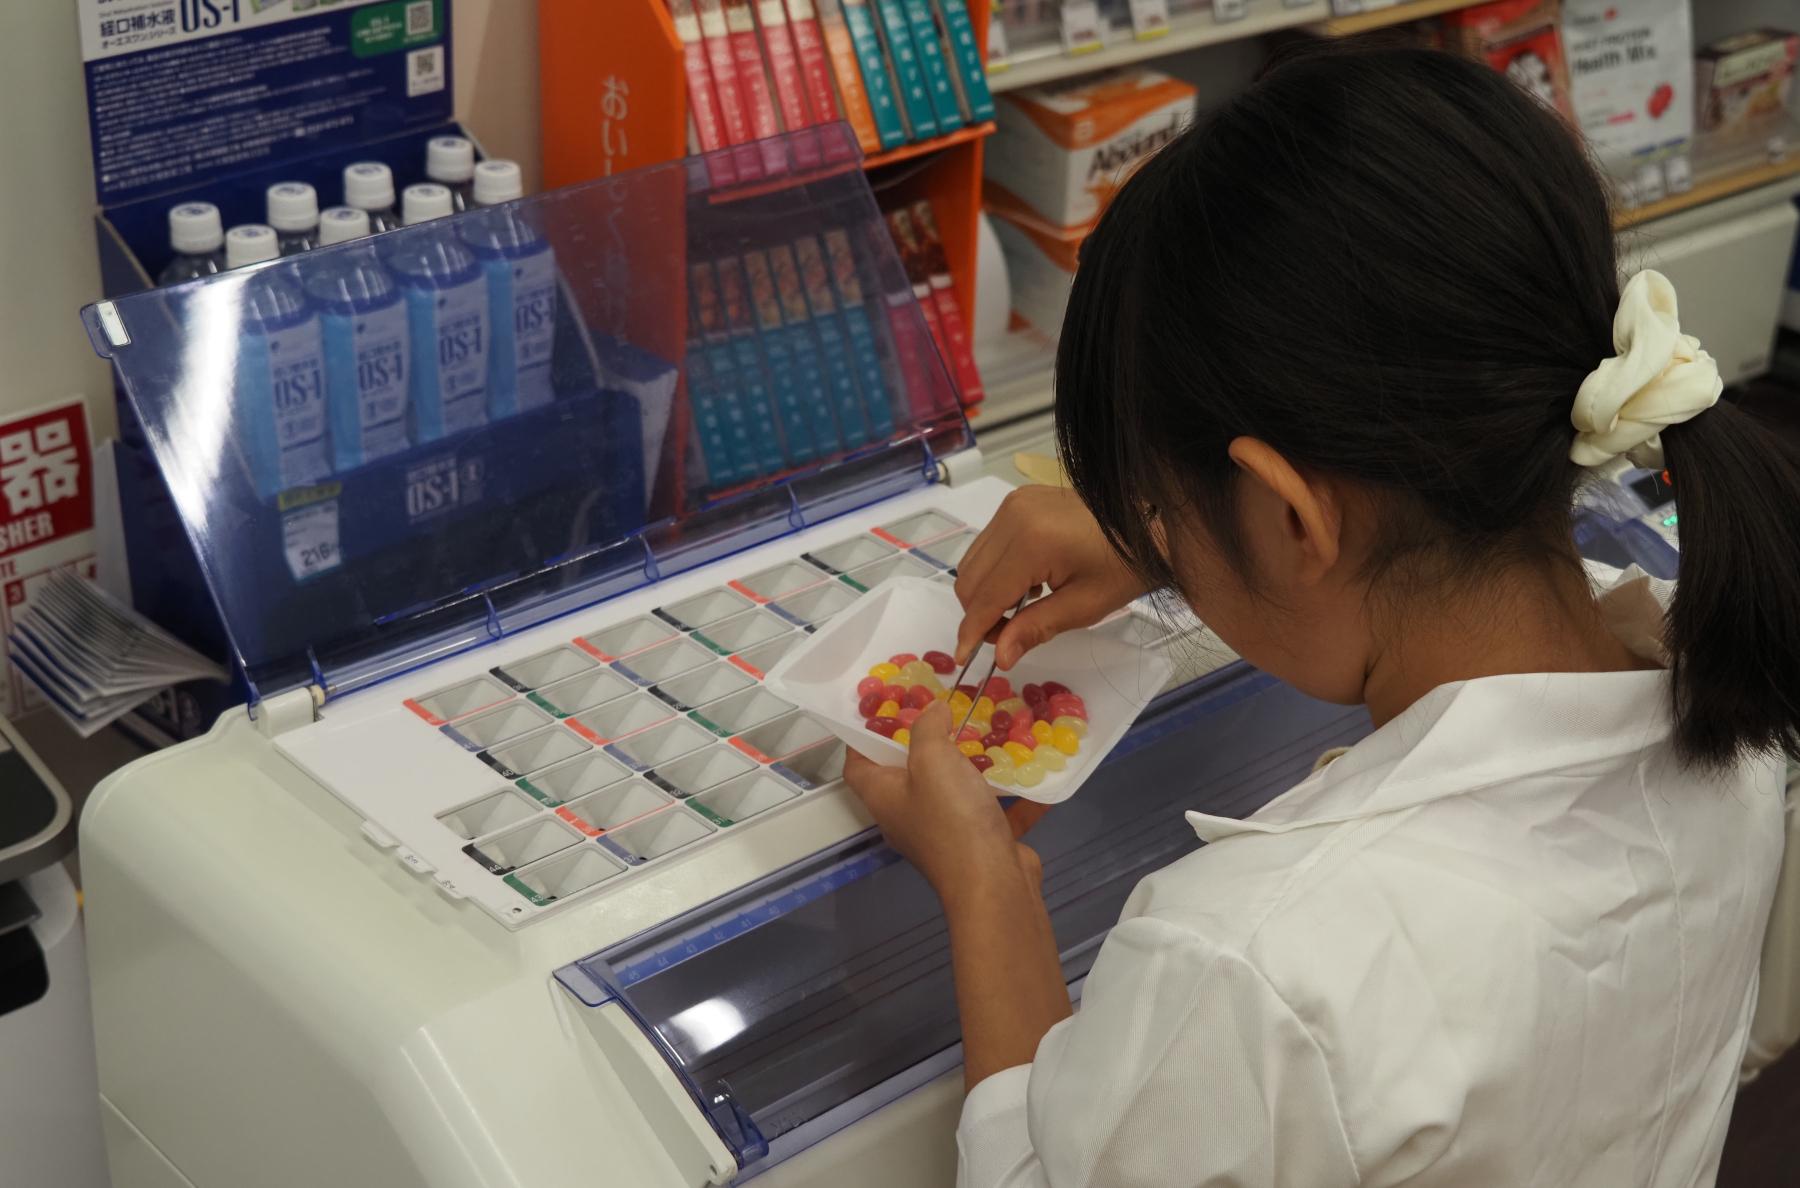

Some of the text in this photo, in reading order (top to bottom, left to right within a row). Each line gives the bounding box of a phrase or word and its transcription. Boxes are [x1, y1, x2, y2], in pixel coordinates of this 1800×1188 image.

[101, 9, 176, 37] 経口補水液
[440, 327, 482, 366] OS-1
[275, 369, 322, 409] OS-1
[358, 353, 403, 392] OS-1
[409, 469, 459, 517] OS-1
